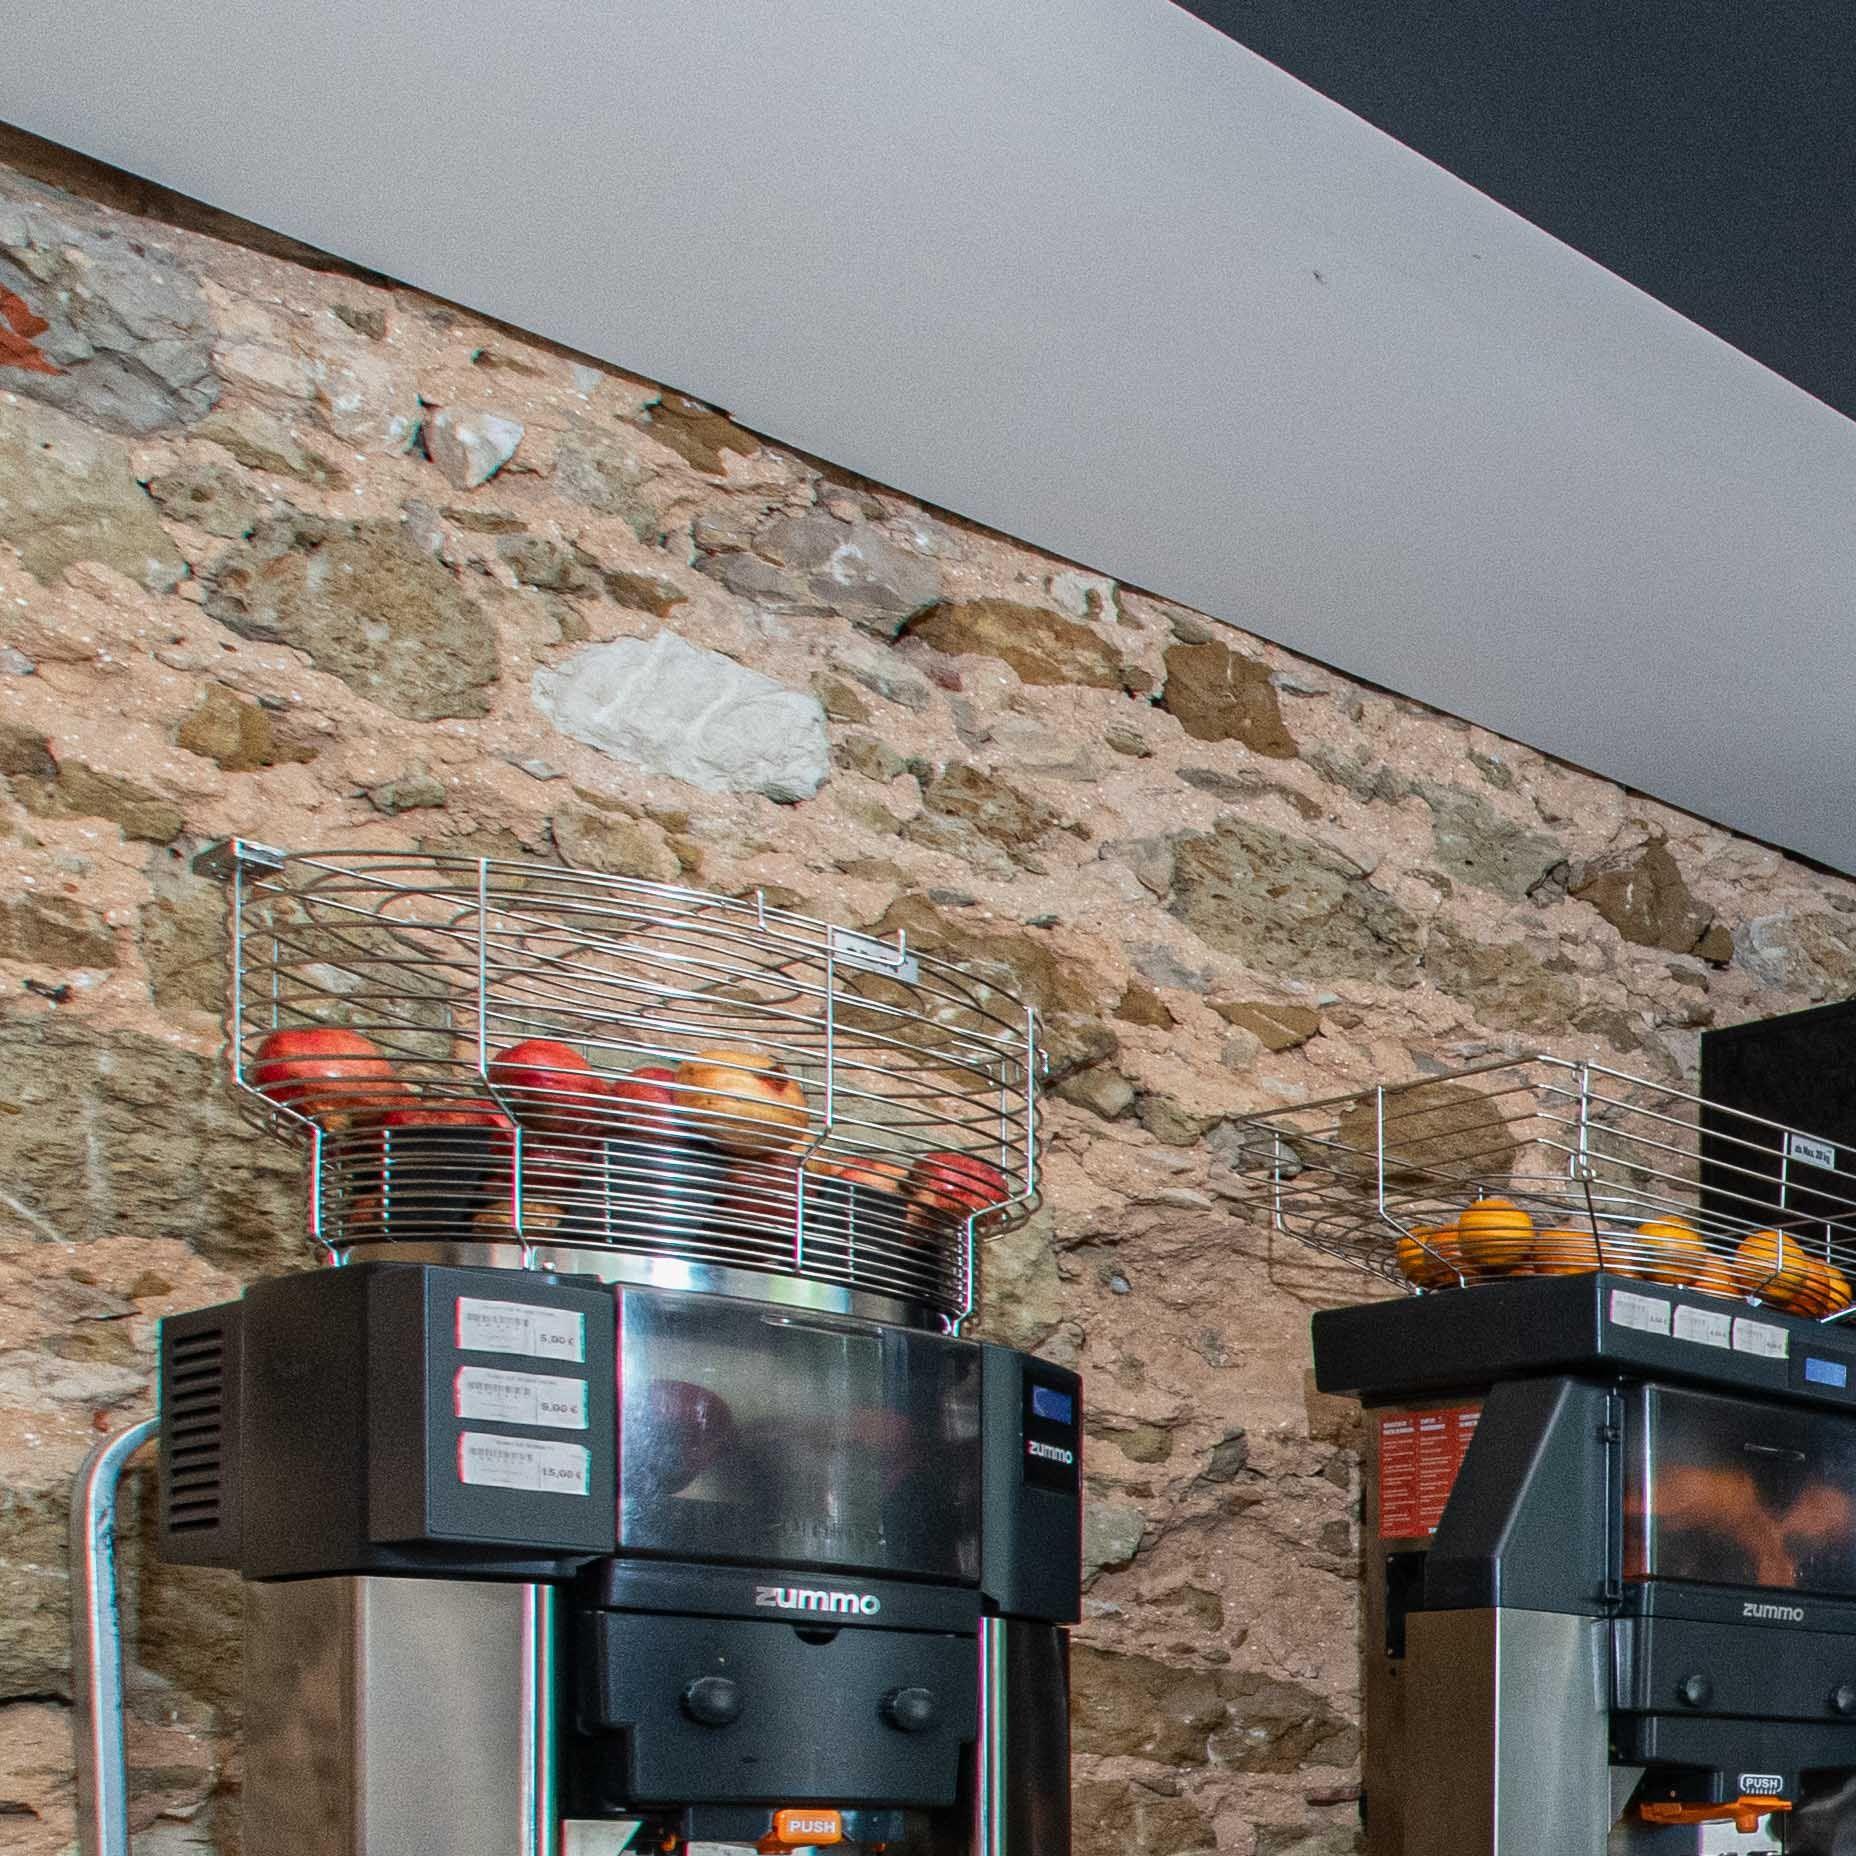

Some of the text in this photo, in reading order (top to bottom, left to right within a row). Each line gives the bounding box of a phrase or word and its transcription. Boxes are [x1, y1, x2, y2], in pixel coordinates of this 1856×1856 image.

[1028, 1440, 1073, 1465] zummo
[755, 1585, 881, 1615] zummo
[1742, 1603, 1805, 1622] zummo
[1746, 1777, 1779, 1791] PUSH
[788, 1817, 837, 1836] PUSH
